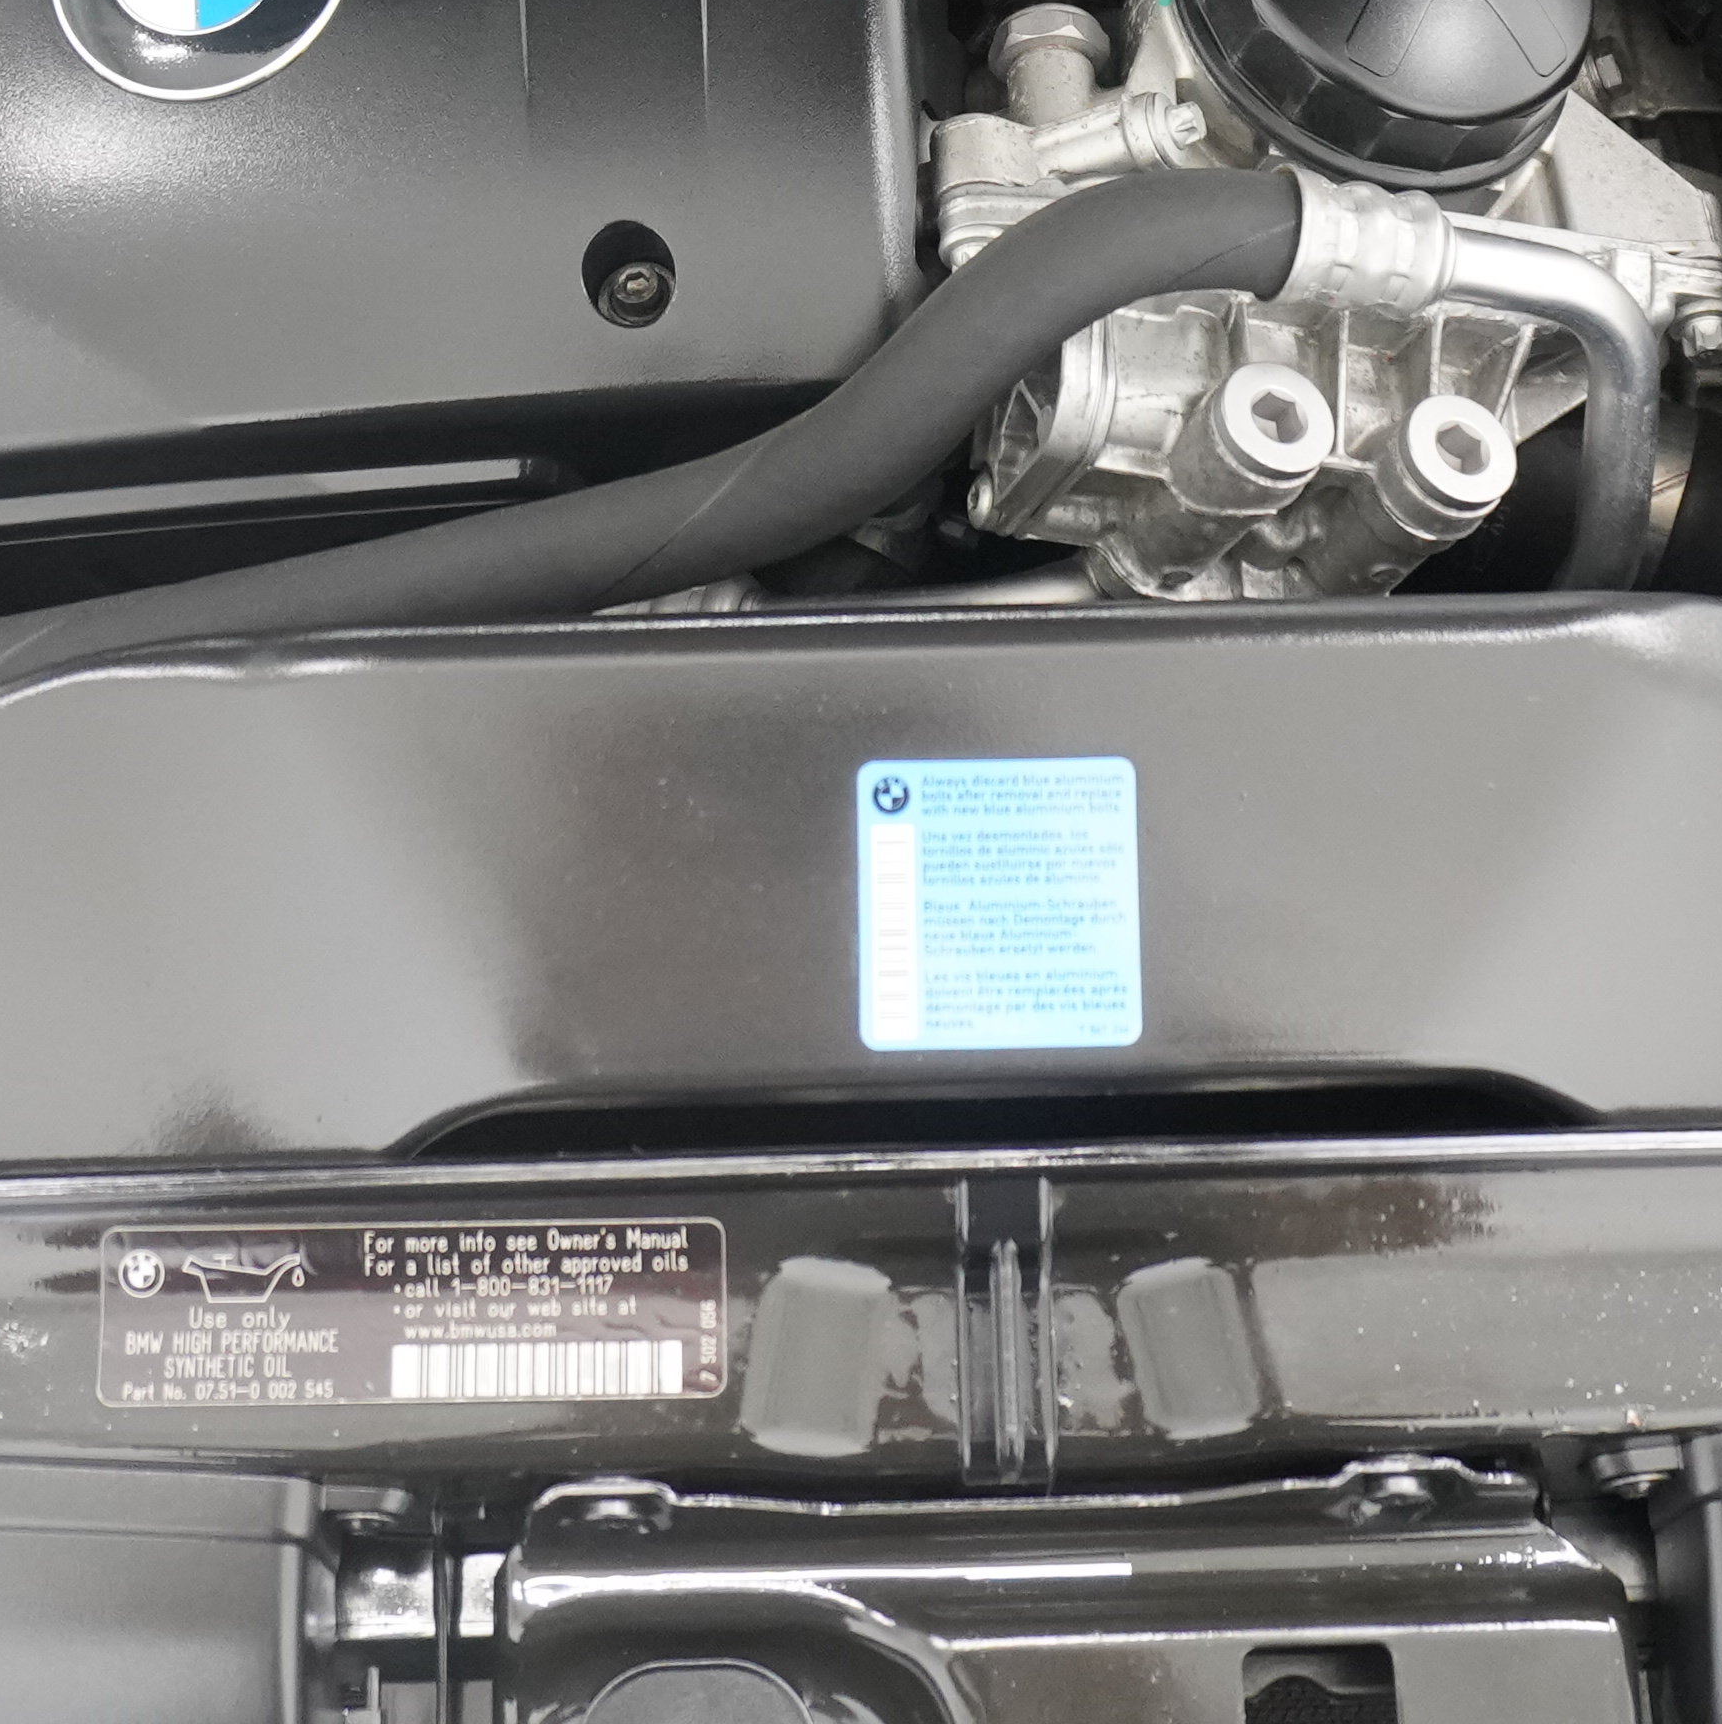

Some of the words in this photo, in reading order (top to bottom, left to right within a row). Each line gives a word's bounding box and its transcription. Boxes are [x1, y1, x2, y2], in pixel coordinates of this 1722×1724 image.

[364, 1230, 395, 1254] For
[404, 1234, 449, 1254] more
[459, 1228, 496, 1253] info
[506, 1233, 538, 1252] see
[547, 1228, 617, 1252] Owner's
[626, 1227, 688, 1250] Manual
[364, 1255, 395, 1277] For
[405, 1259, 417, 1276] a
[427, 1254, 460, 1275] list
[471, 1253, 491, 1274] of
[501, 1253, 550, 1274] other
[560, 1251, 642, 1280] approved
[652, 1250, 689, 1273] oils
[451, 1273, 613, 1297] 1-800-831-1117
[189, 1305, 227, 1329] Use
[242, 1305, 292, 1332] only
[435, 1297, 477, 1318] visit
[486, 1302, 517, 1316] our
[527, 1297, 561, 1316] web
[571, 1296, 608, 1316] site
[617, 1295, 637, 1315] at
[698, 1298, 717, 1329] 056
[125, 1331, 163, 1355] BMW
[172, 1331, 212, 1354] HIGH
[221, 1329, 339, 1354] PERFORMANCE
[403, 1322, 557, 1340] www.bmwusa.com
[698, 1334, 717, 1364] 502
[164, 1356, 254, 1379] SYNTHETIC
[264, 1355, 292, 1378] OIL
[122, 1382, 154, 1401] Part
[163, 1383, 186, 1401] No.
[267, 1380, 297, 1400] 002
